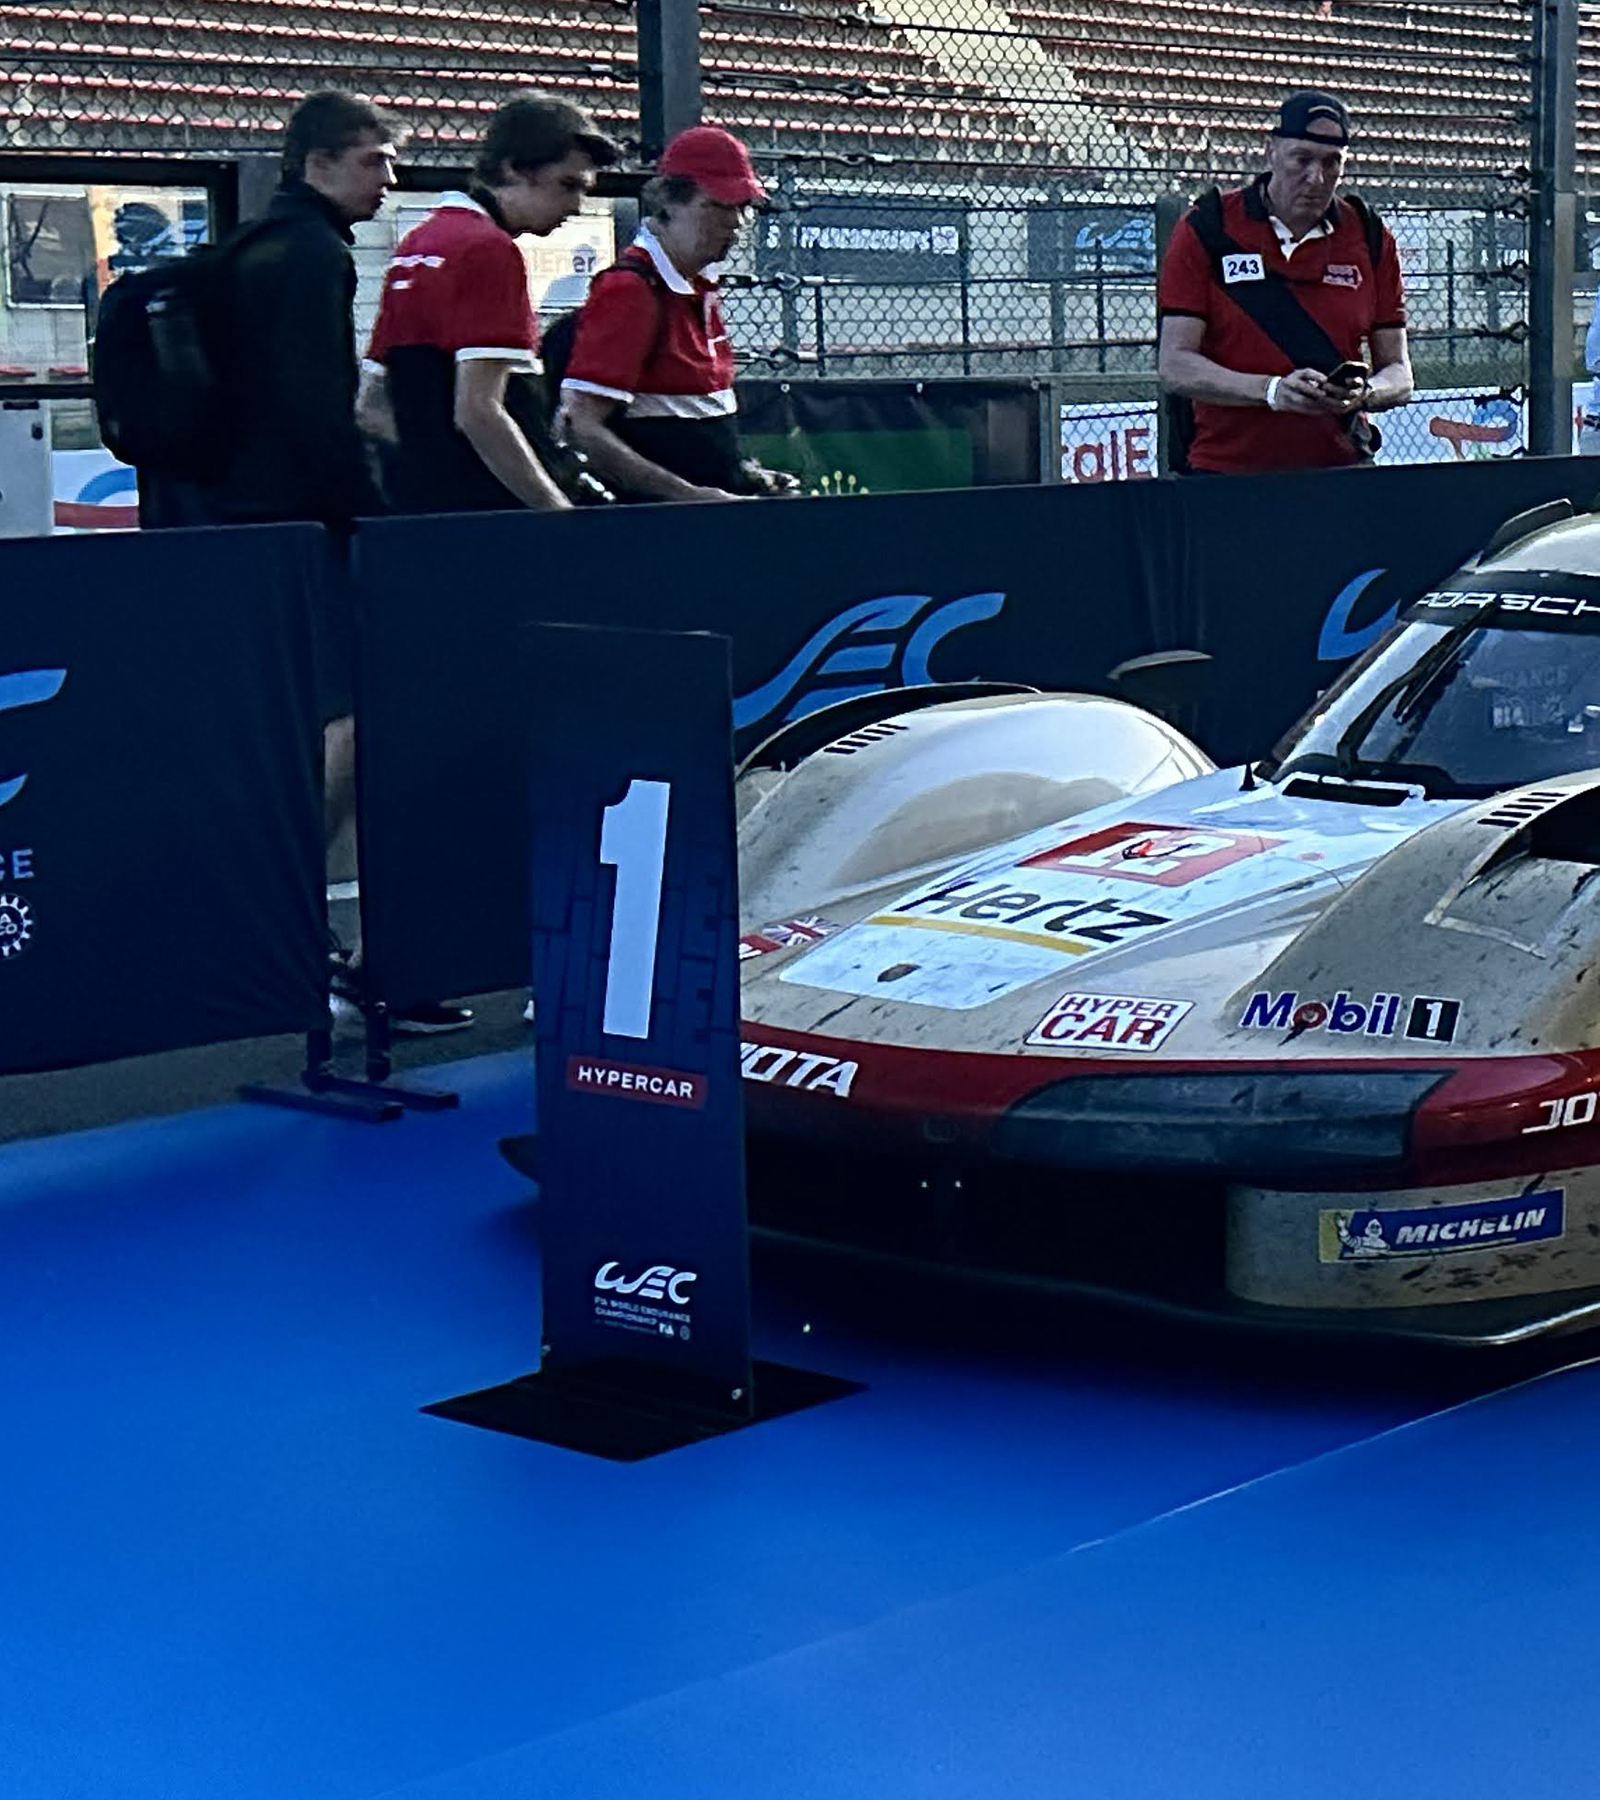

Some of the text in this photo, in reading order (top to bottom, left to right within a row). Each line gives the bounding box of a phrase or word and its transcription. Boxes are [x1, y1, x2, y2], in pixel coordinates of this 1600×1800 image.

[1227, 259, 1260, 277] 243
[600, 779, 671, 1039] 1
[892, 881, 1173, 943] Hertz
[1061, 996, 1179, 1019] HYPER
[1241, 991, 1402, 1037] Mobil
[1041, 1012, 1167, 1046] CAR
[577, 1064, 695, 1099] HYPERCAR
[1395, 1206, 1548, 1245] MICHELIN
[594, 1261, 697, 1305] WEC
